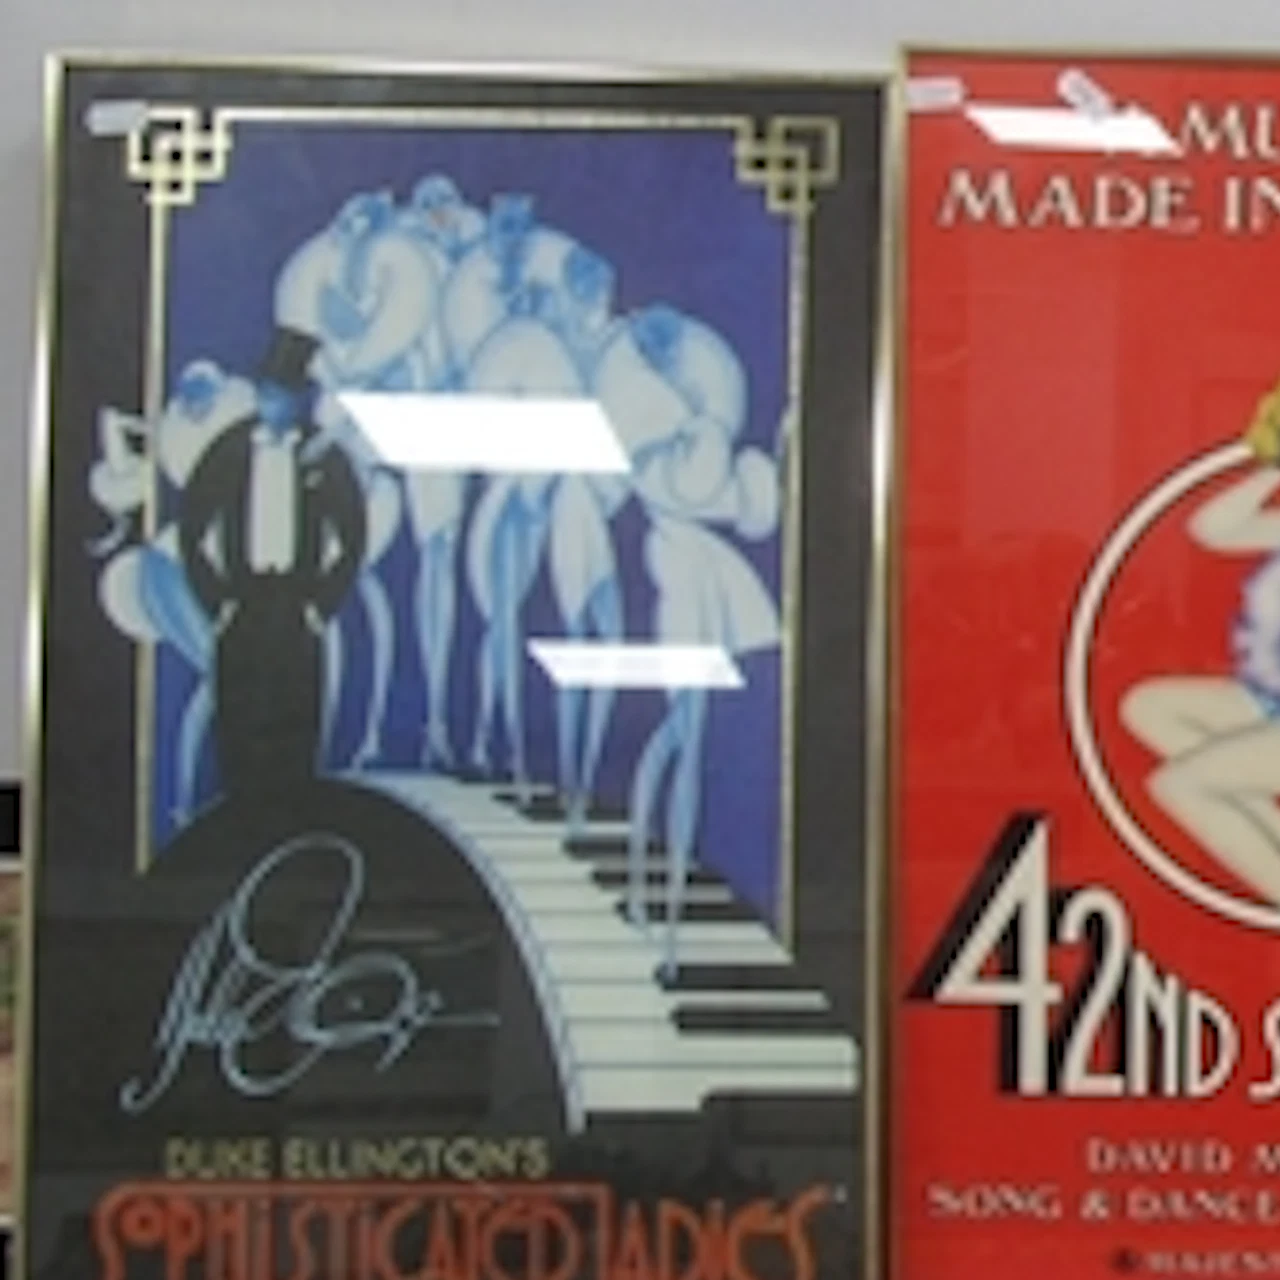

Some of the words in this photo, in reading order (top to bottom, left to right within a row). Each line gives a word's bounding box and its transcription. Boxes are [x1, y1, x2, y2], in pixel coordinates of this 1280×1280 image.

[937, 169, 1202, 233] MADE
[165, 1135, 272, 1179] DUKE
[1087, 1136, 1234, 1174] DAVID
[926, 1181, 1063, 1221] SONG
[1078, 1187, 1121, 1220] &
